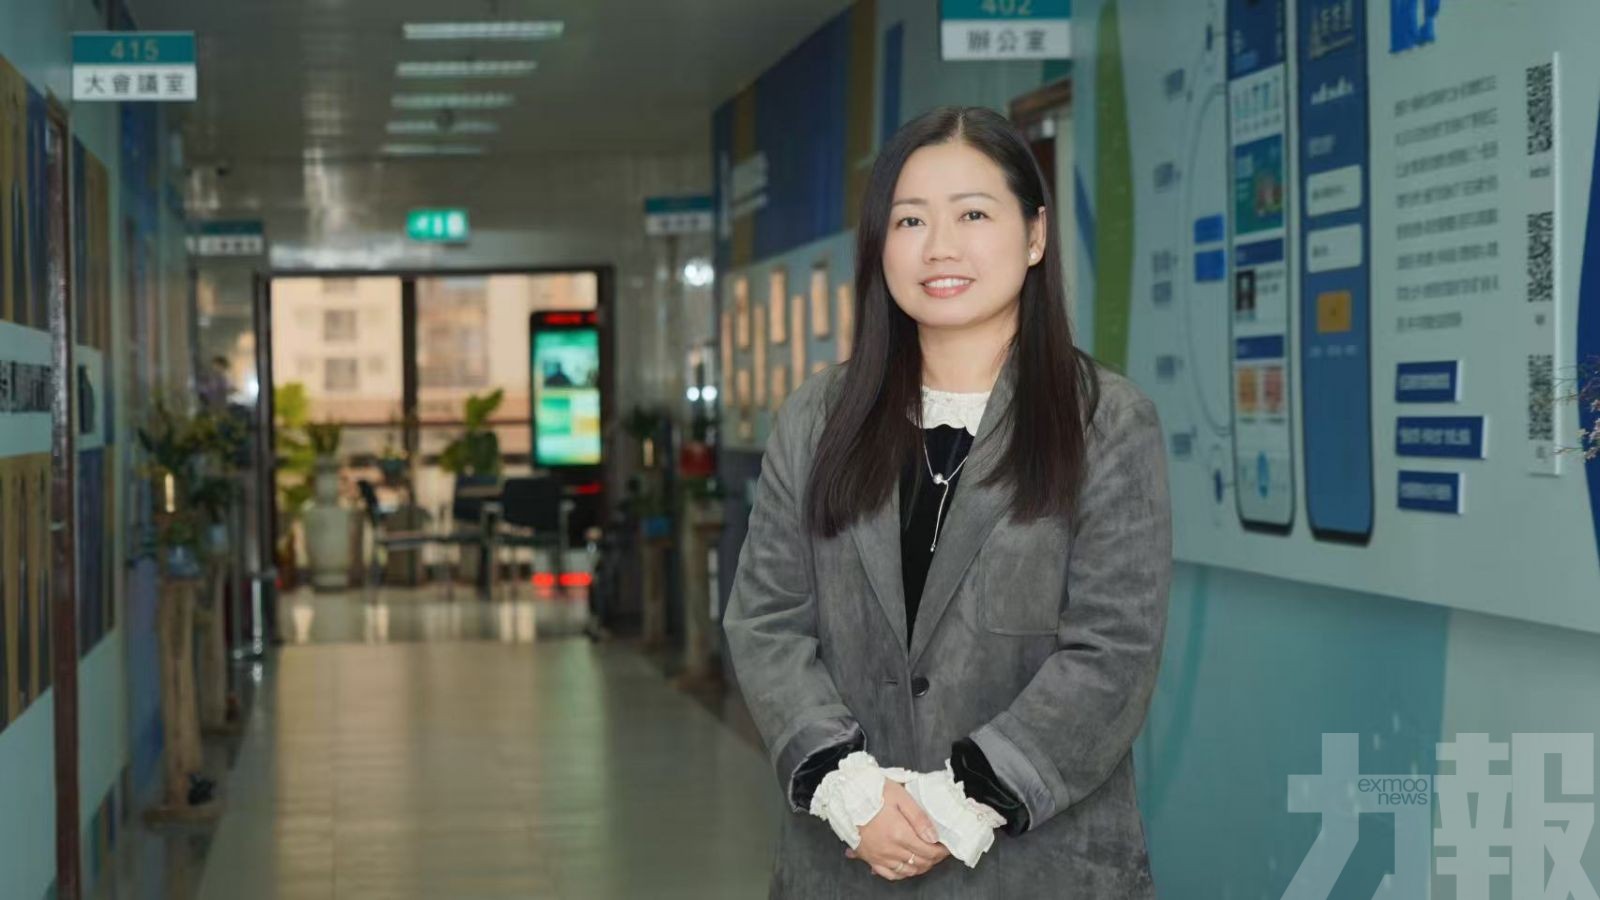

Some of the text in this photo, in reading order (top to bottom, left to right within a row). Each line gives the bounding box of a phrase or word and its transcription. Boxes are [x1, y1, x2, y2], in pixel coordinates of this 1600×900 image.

[110, 39, 160, 60] 415
[968, 30, 1046, 52] 辦公室
[84, 73, 187, 95] 大會議室
